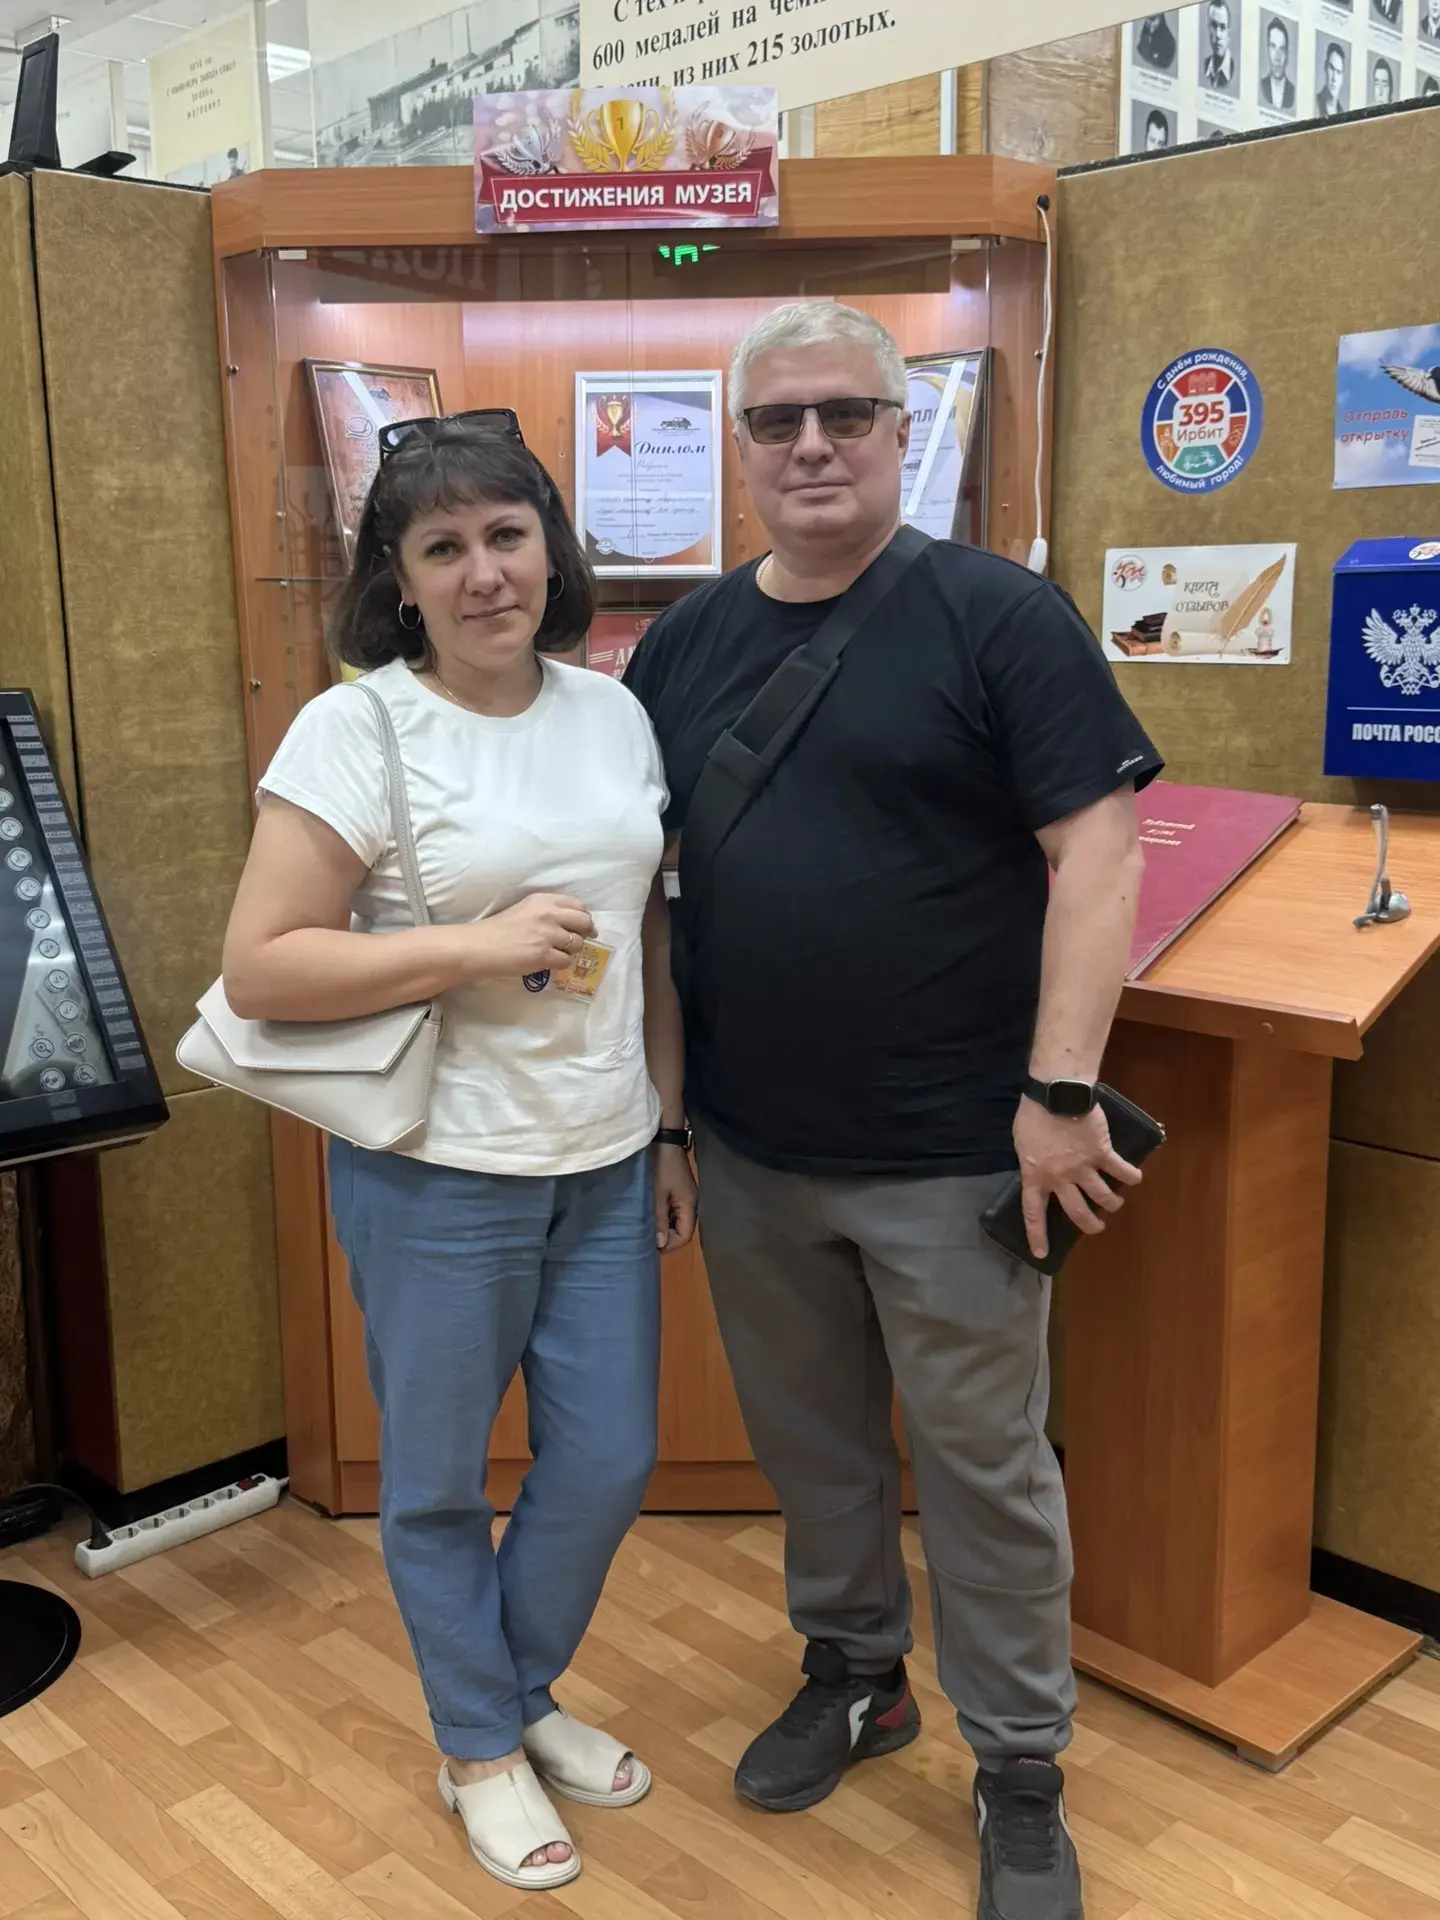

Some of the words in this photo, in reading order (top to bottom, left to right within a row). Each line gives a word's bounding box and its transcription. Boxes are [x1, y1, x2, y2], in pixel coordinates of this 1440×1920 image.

[613, 0, 629, 22] С
[592, 39, 625, 70] 600
[635, 10, 720, 58] медалей
[732, 5, 758, 30] на
[673, 66, 695, 87] из
[702, 53, 740, 80] них
[747, 33, 784, 67] 215
[790, 9, 896, 56] золотых.
[616, 116, 625, 132] 1
[500, 185, 664, 212] ДОСТИЖЕНИЯ
[675, 183, 752, 206] МУЗЕЯ
[1157, 380, 1166, 390] С
[1165, 355, 1193, 384] днём
[1194, 351, 1248, 382] рождения,
[1178, 401, 1225, 427] 395
[1342, 408, 1408, 424] Отправь
[1177, 426, 1225, 443] Ирбит
[1340, 428, 1409, 445] открытку
[634, 440, 706, 455] Диплом
[1210, 454, 1244, 485] город!
[1352, 723, 1401, 741] ПОЧТА
